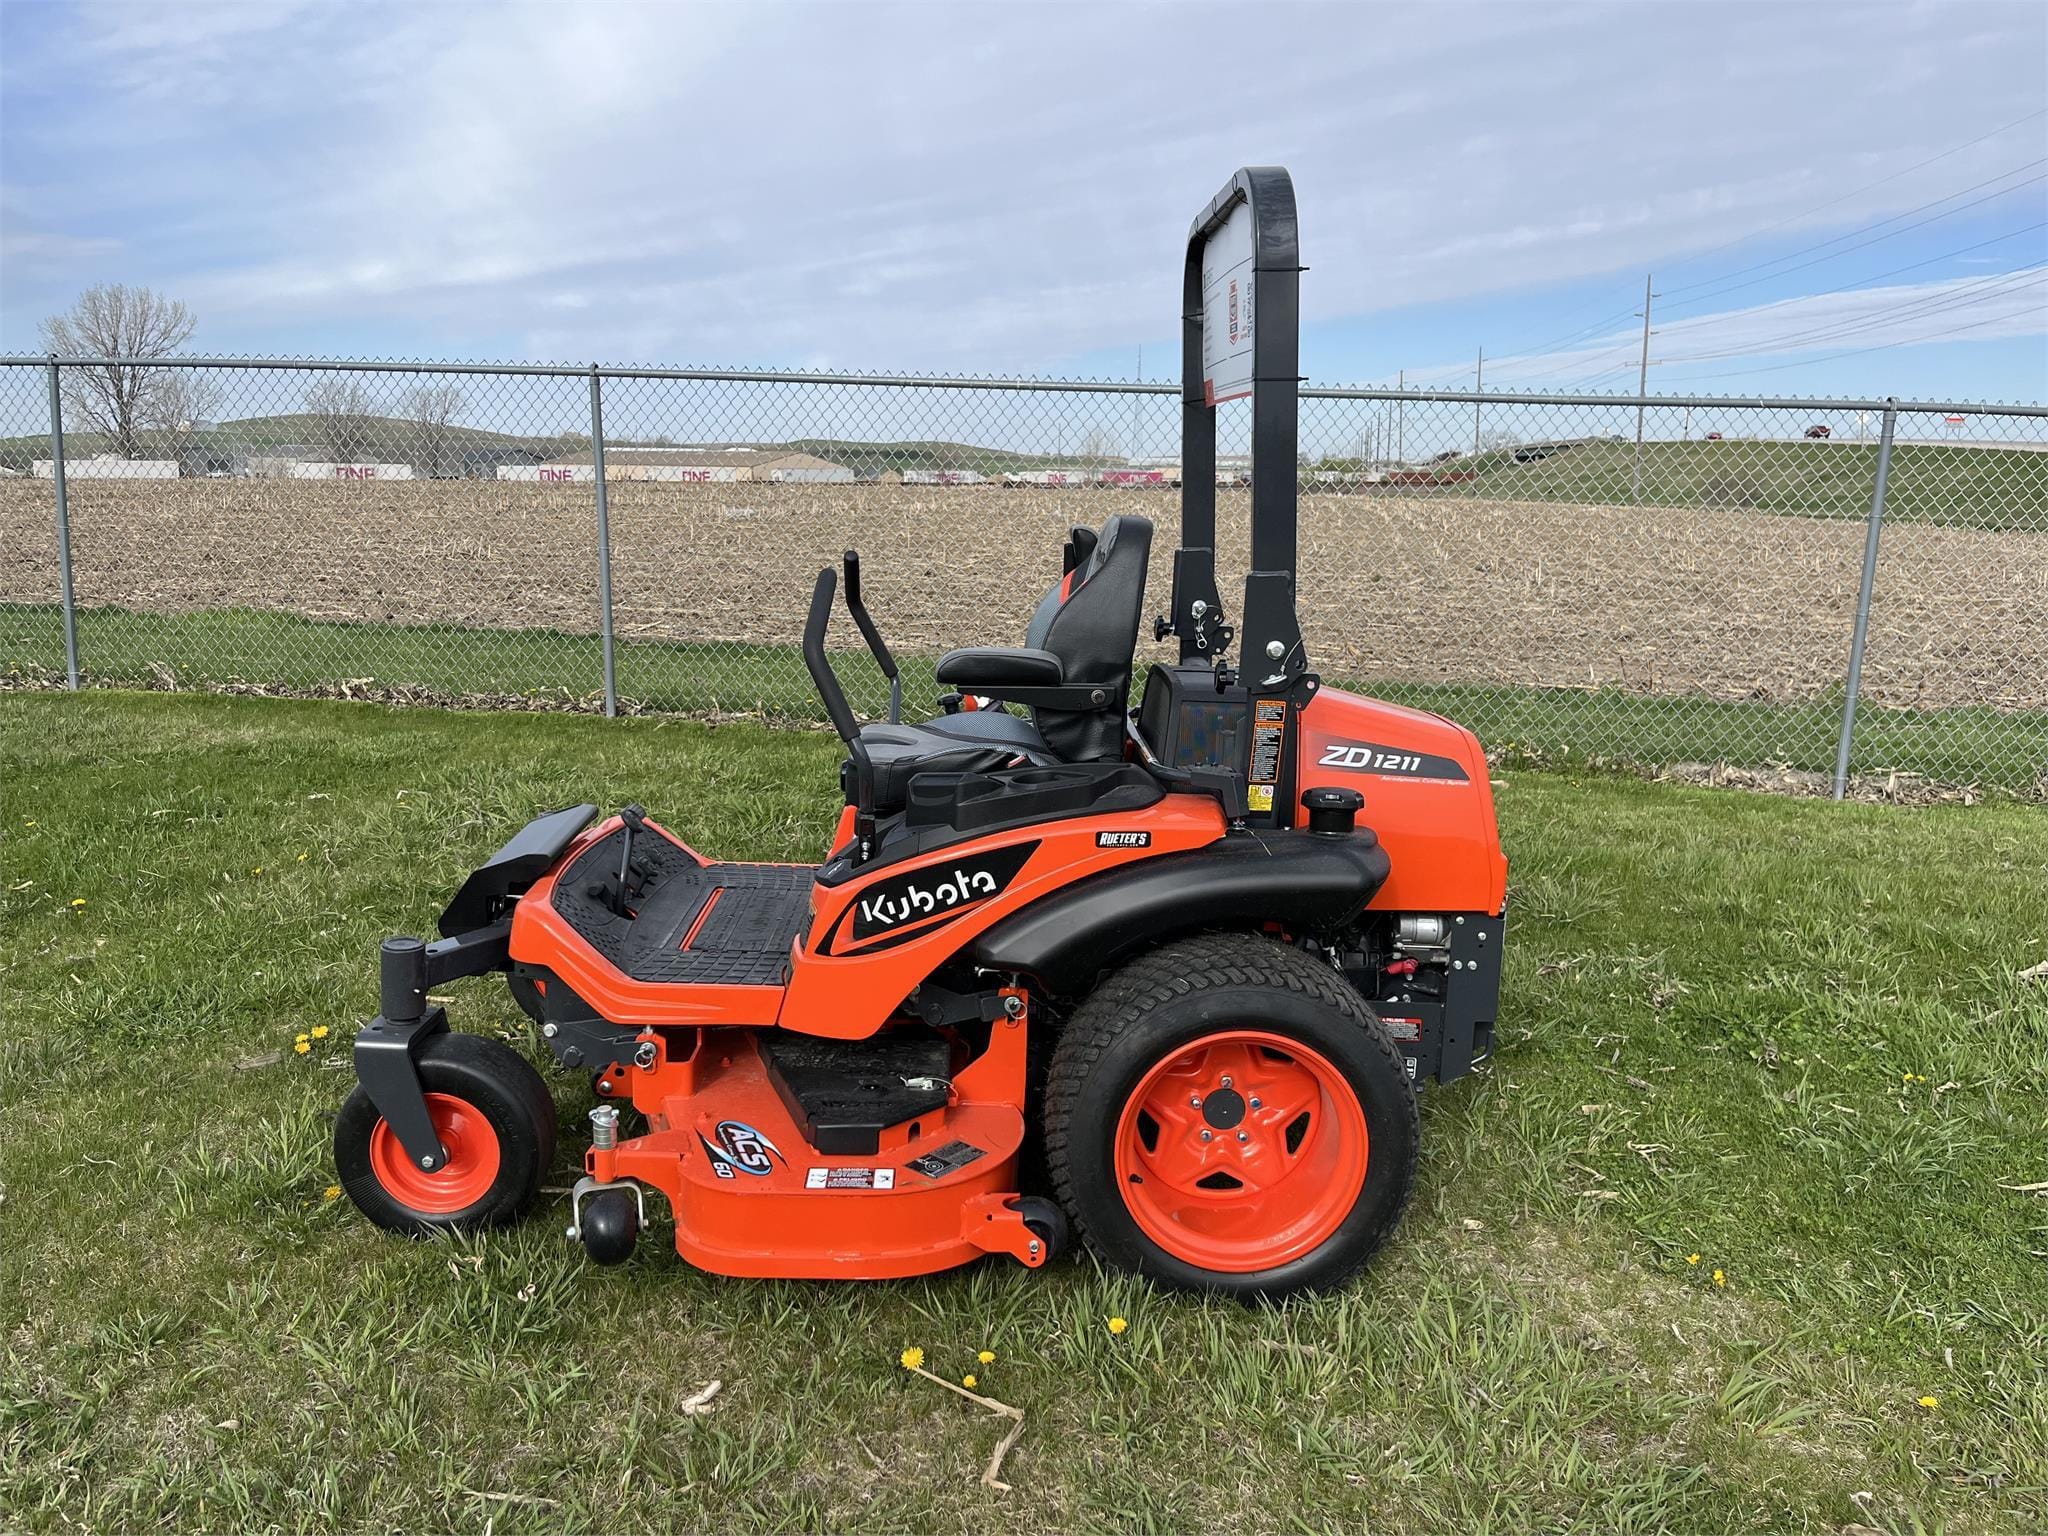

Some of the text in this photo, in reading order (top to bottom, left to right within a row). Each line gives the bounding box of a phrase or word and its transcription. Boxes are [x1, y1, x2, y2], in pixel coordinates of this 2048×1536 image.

[1318, 745, 1422, 771] ZD 1211
[1099, 832, 1147, 846] RUETER'S
[860, 869, 997, 925] Kubota
[727, 1127, 771, 1167] ACS
[713, 1161, 734, 1178] 60
